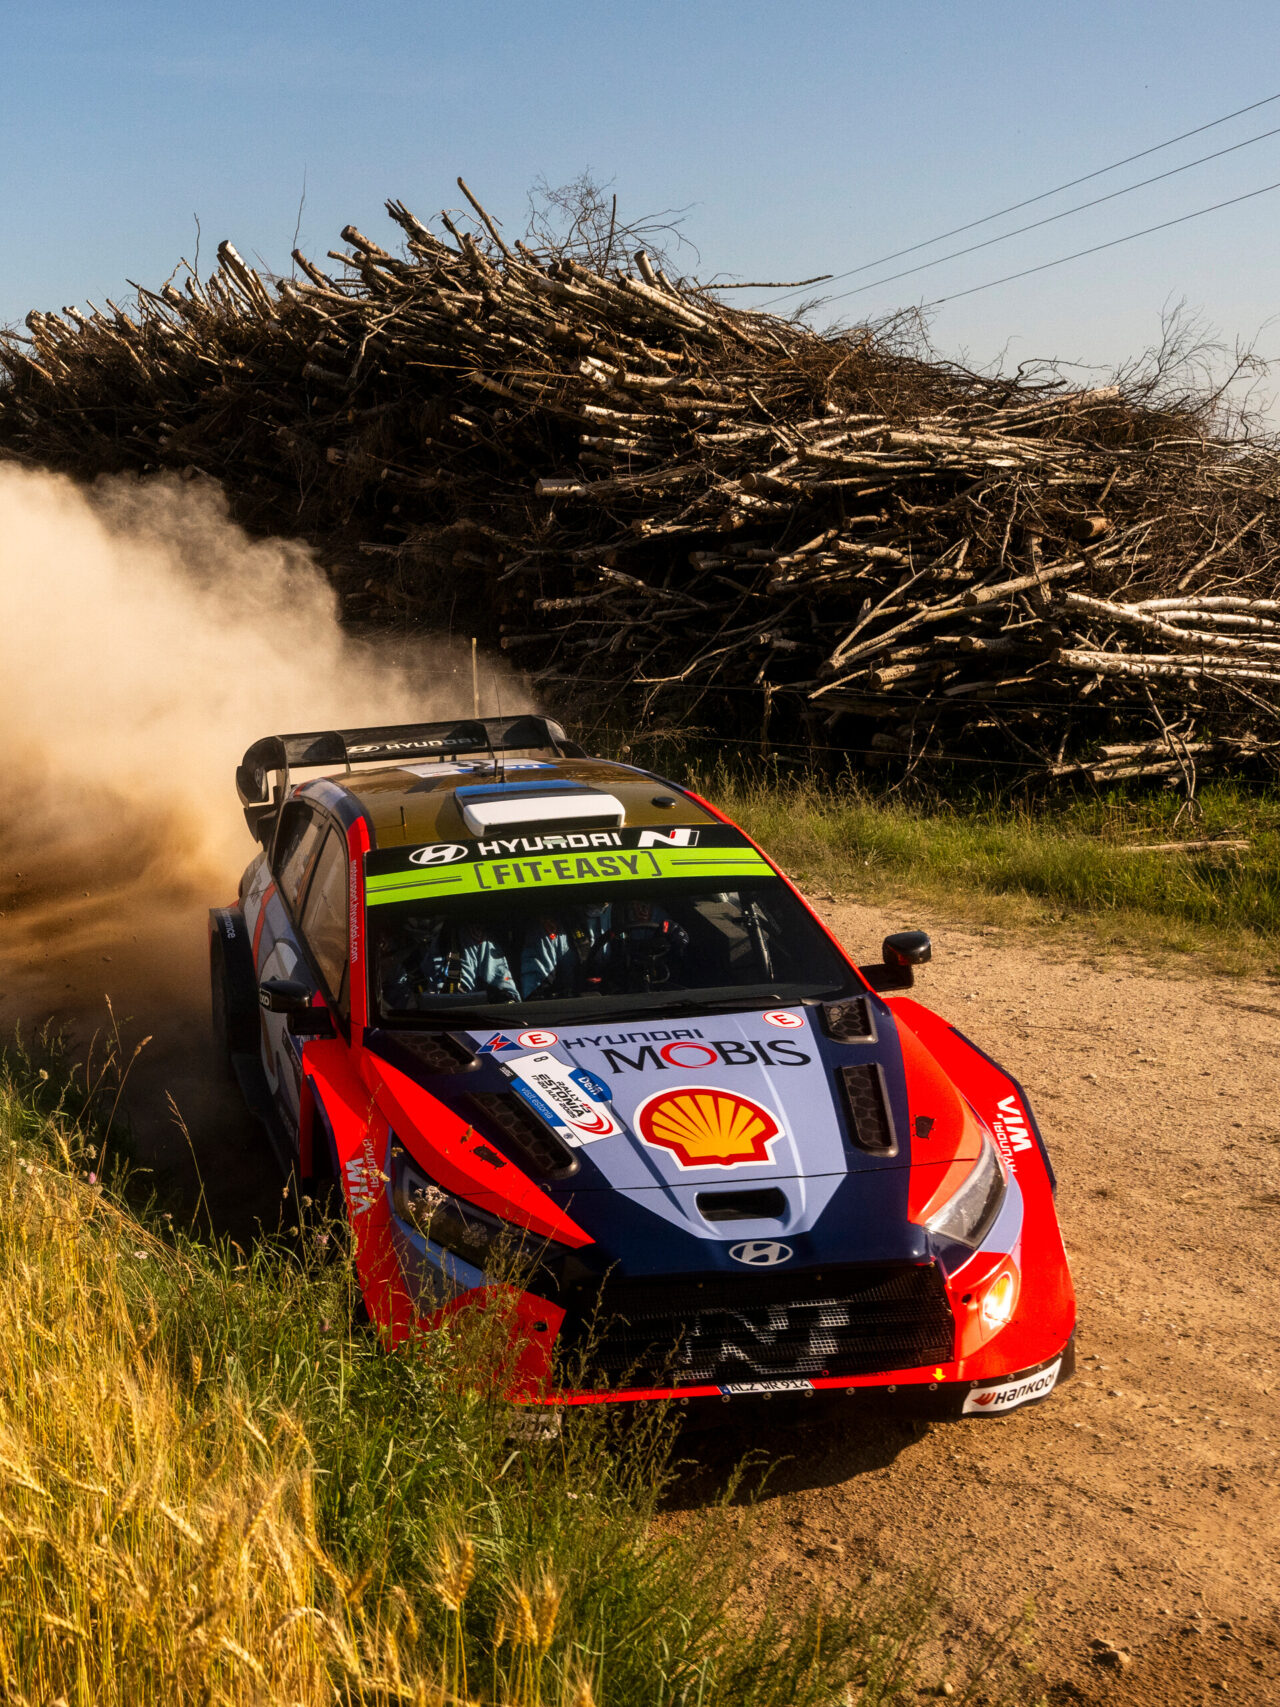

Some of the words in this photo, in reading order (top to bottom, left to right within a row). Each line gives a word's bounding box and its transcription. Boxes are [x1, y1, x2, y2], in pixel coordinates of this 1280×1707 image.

[386, 738, 478, 750] HYUNDAI
[477, 832, 623, 856] HYUNDAI
[774, 1012, 795, 1026] E
[528, 1033, 548, 1045] E
[562, 1028, 705, 1050] HYUNDAI
[533, 1055, 549, 1063] 8
[600, 1039, 811, 1074] MOBIS
[530, 1074, 547, 1091] 17-20
[546, 1088, 561, 1104] JULY
[559, 1102, 579, 1119] 2025
[538, 1073, 585, 1118] ESTONIA
[556, 1081, 582, 1103] RALLY
[578, 1076, 604, 1096] Delfi
[521, 1087, 534, 1101] visit
[532, 1097, 554, 1119] estonia
[993, 1121, 1018, 1172] HYUNDAI
[730, 1383, 759, 1393] ALZ
[761, 1381, 780, 1391] WR
[780, 1379, 809, 1389] 914
[993, 1371, 1055, 1405] Hankoo
